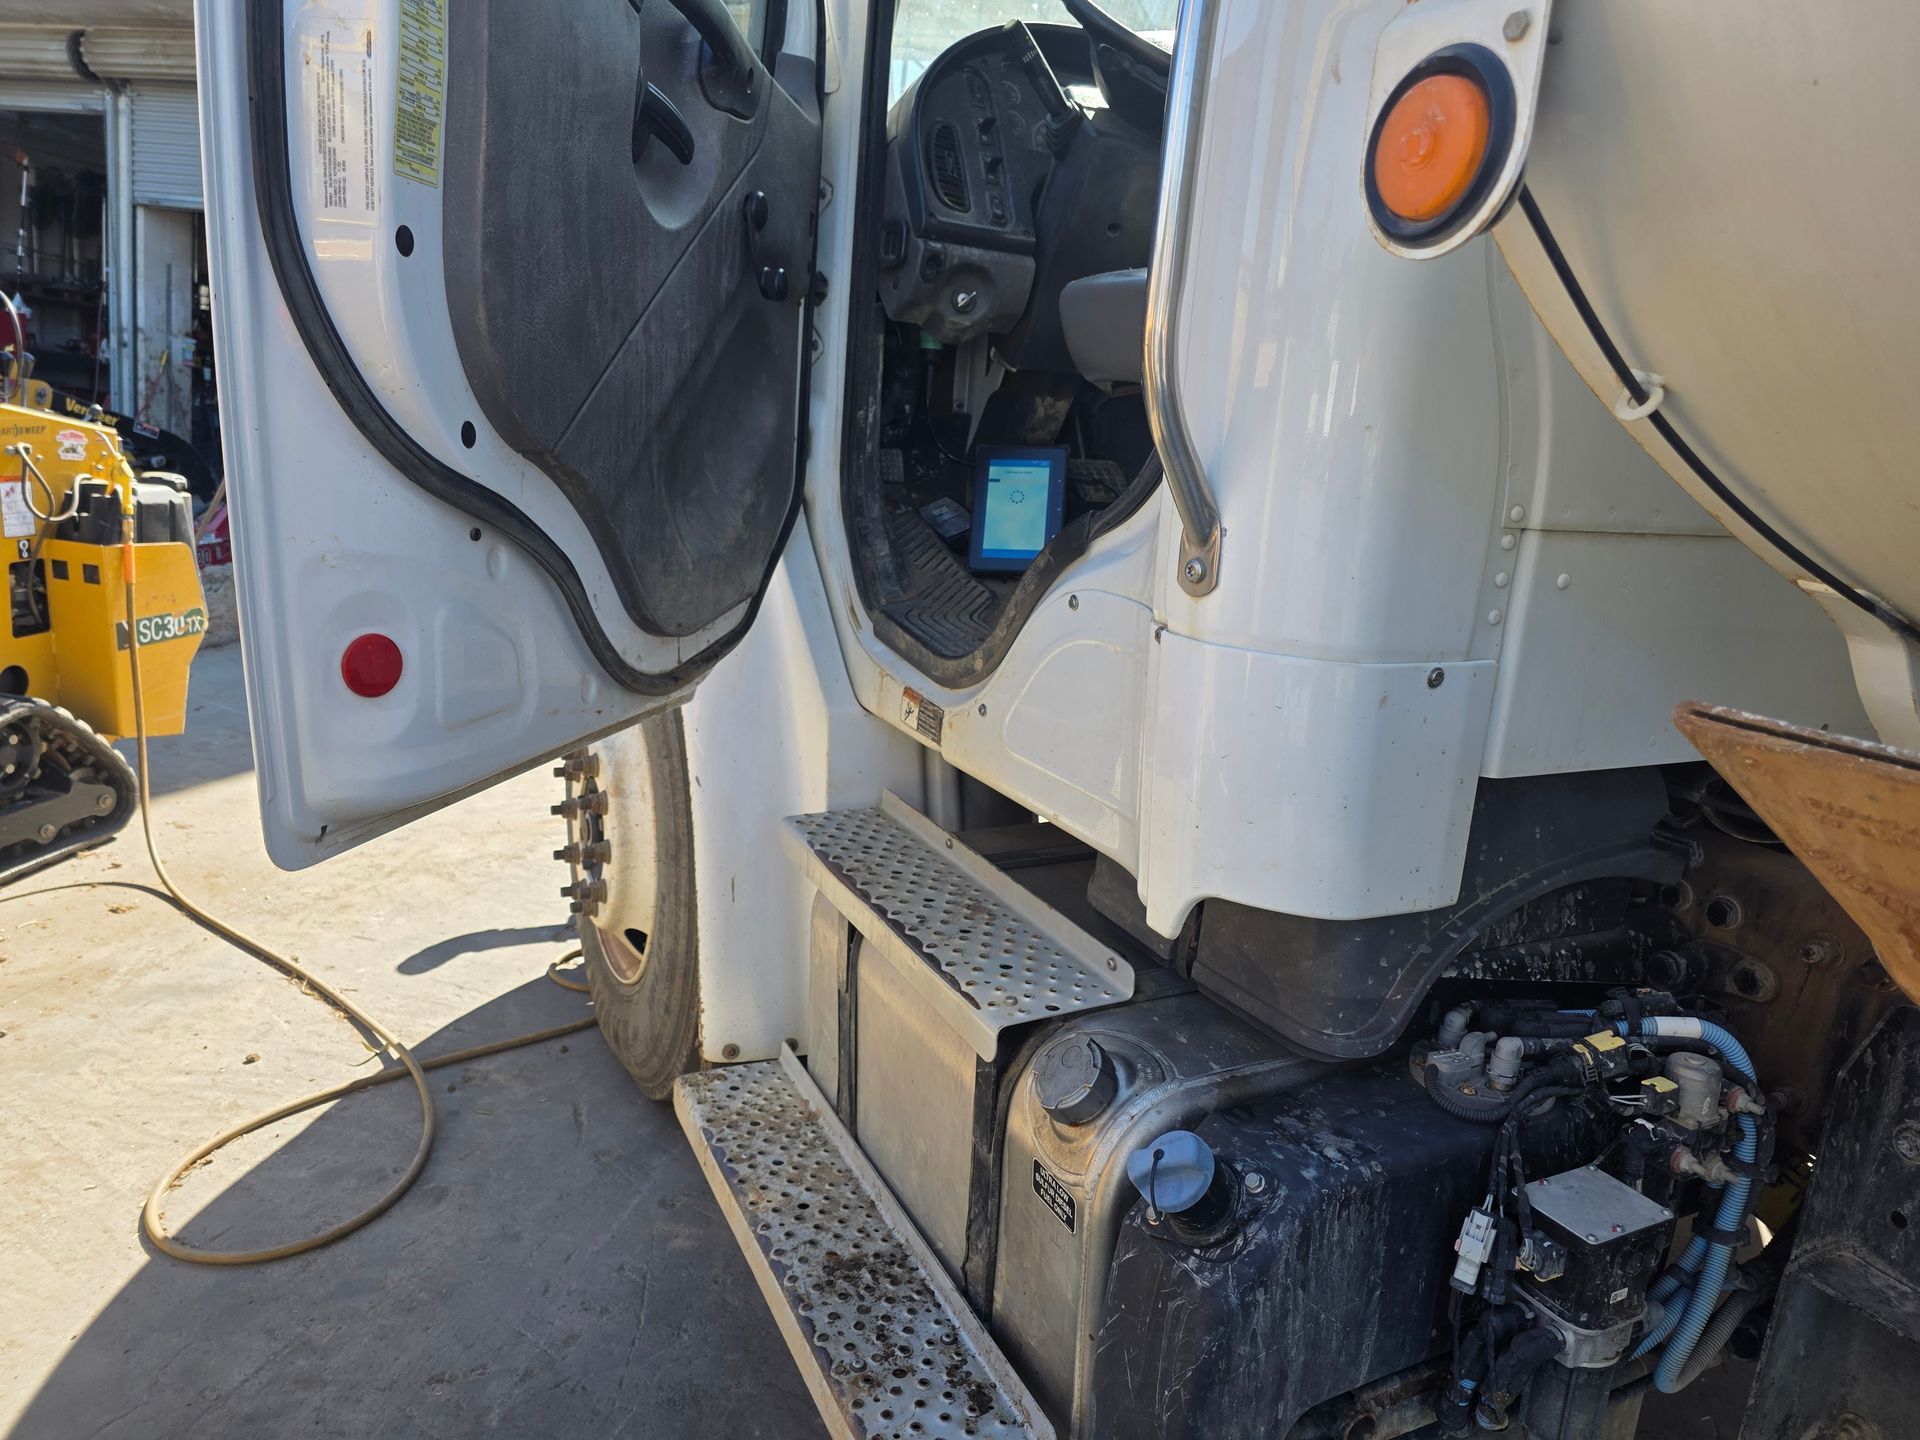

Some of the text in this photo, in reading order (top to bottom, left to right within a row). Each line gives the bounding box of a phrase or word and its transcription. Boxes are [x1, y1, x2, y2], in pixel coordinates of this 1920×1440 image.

[66, 397, 118, 427] Vereer
[1035, 1172, 1073, 1219] SULFUR DIESEL
[1040, 1167, 1069, 1202] ULTRA LOW
[1040, 1188, 1067, 1221] FUEL ONLY
